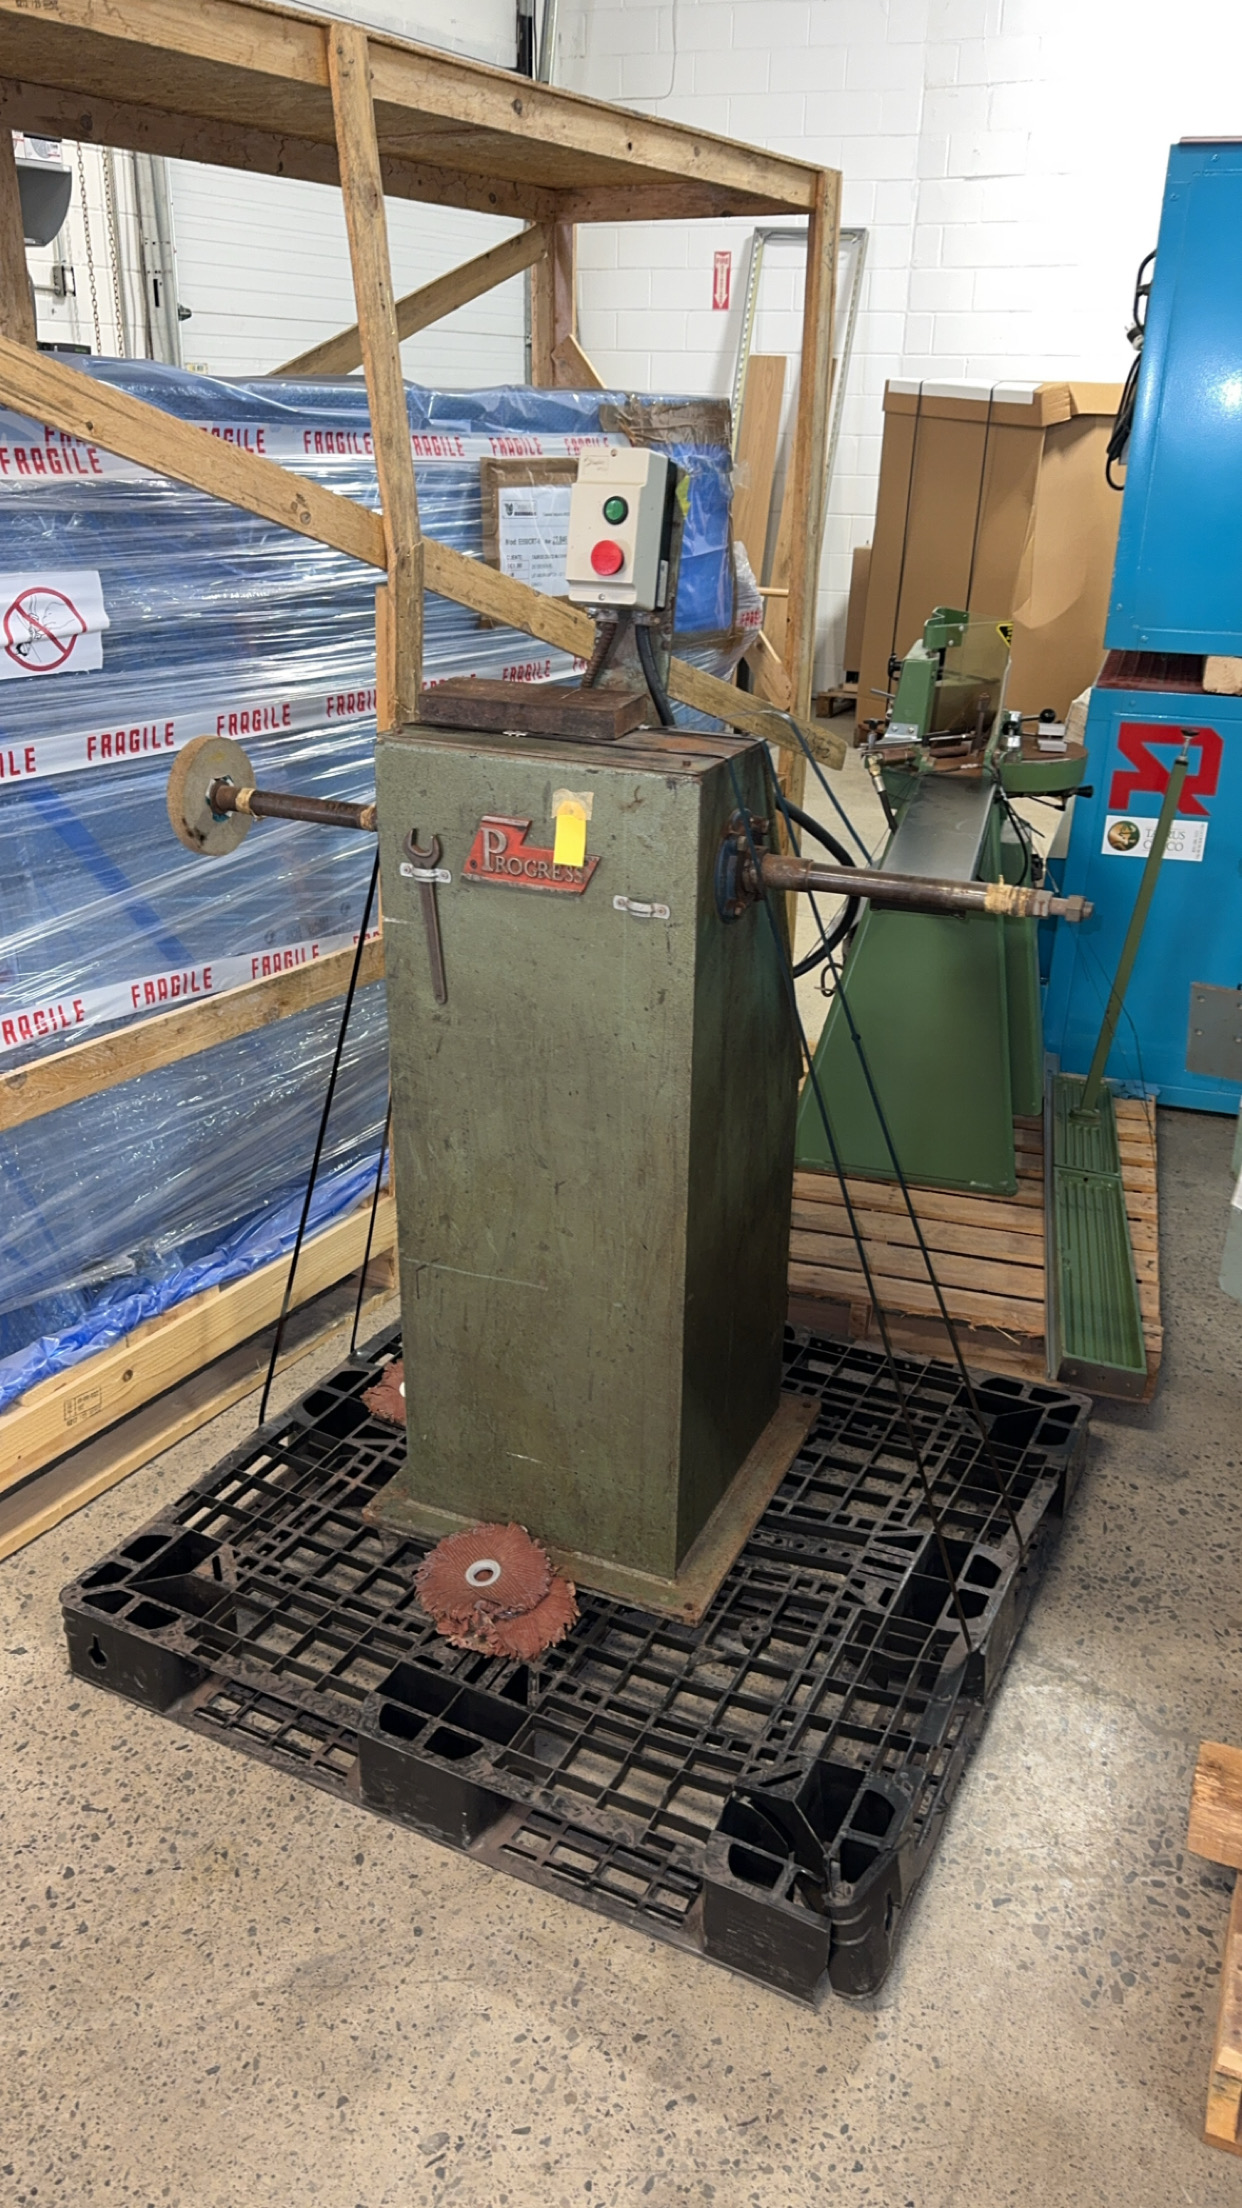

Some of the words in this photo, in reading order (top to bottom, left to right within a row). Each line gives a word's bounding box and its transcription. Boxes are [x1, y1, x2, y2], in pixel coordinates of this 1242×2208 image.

[199, 427, 266, 454] GILE
[303, 430, 373, 454] FRAGILE
[412, 435, 465, 456] RAGILE
[488, 437, 542, 457] FRAGILE
[0, 447, 103, 475] FRAGILE
[502, 660, 551, 683] FRAGILE
[87, 722, 175, 761] FRAGILE
[216, 703, 292, 736] FRAGILE
[326, 689, 377, 718] FRAGI
[1, 999, 85, 1045] RAGILE
[131, 967, 213, 1008] FRAGILE
